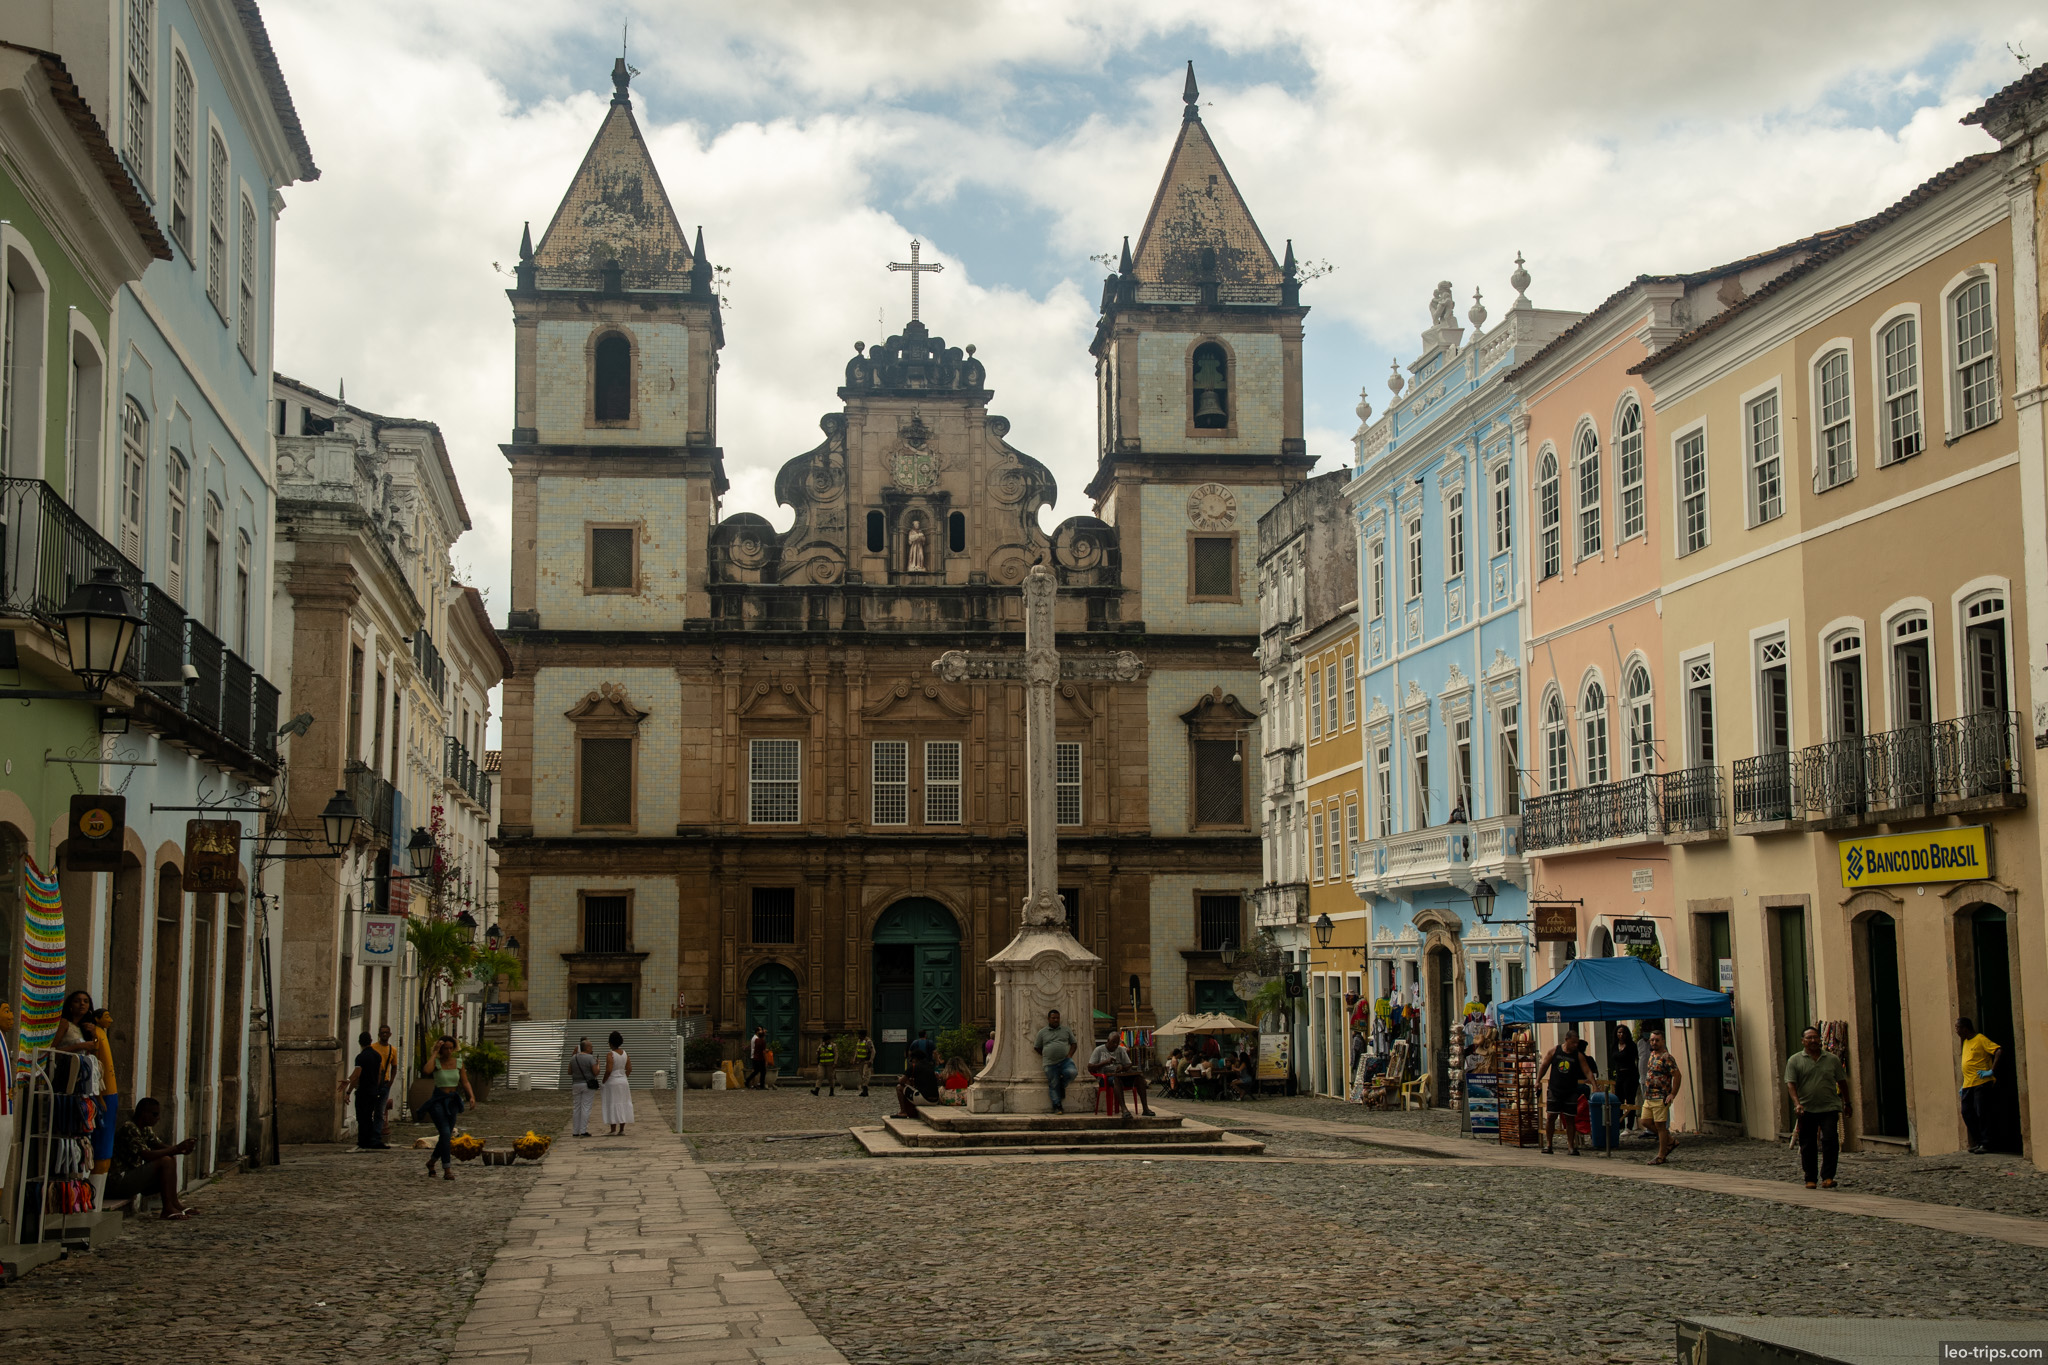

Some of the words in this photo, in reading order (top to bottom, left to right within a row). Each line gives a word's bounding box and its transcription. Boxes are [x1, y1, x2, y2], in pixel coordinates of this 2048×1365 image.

[1866, 849, 1910, 874] BANCO
[1911, 848, 1930, 871] DO
[1930, 844, 1979, 869] BRASIL
[1537, 926, 1576, 935] PALANQUIM
[1616, 925, 1652, 934] ADVOCATUS
